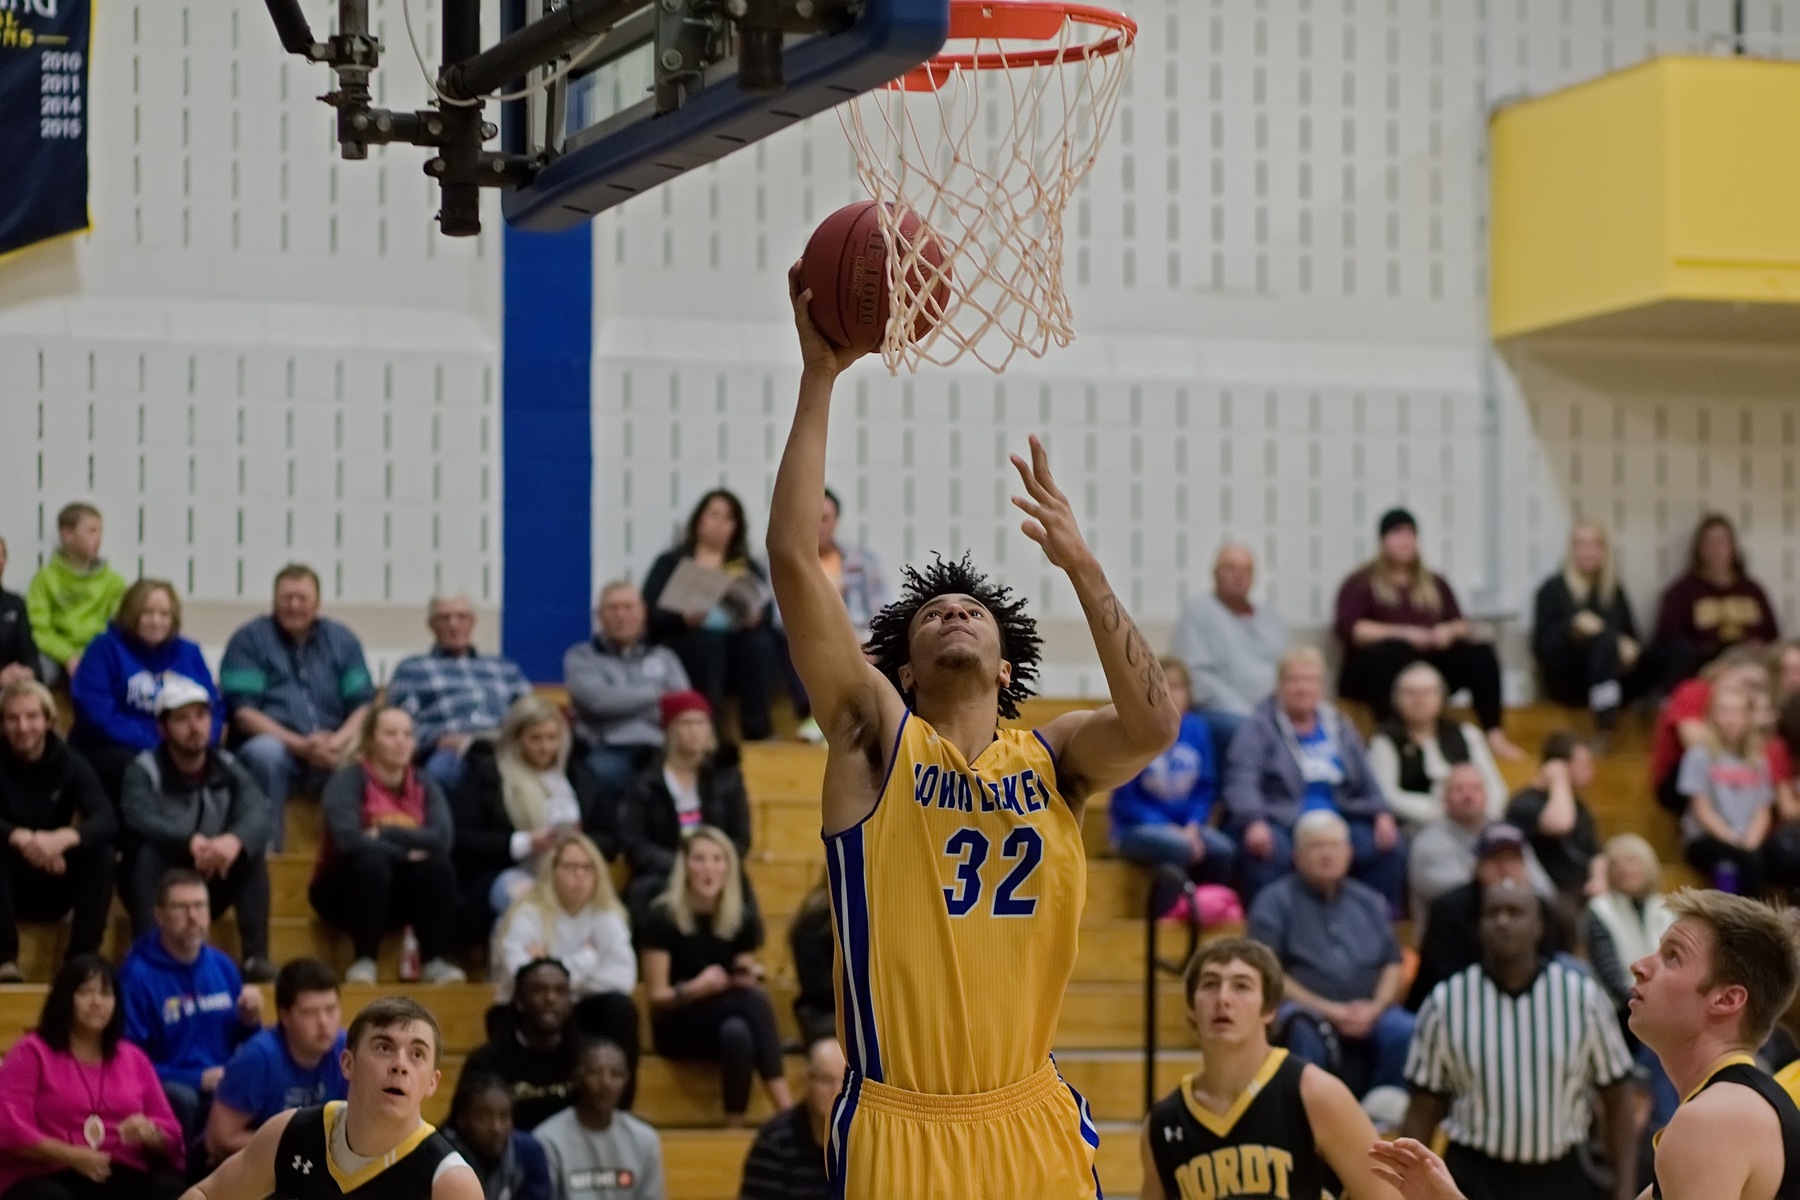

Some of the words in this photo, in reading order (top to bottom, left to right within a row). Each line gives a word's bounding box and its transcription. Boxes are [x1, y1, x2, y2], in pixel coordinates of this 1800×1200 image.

[41, 51, 83, 72] 2010
[41, 73, 80, 94] 2011
[41, 95, 82, 116] 2014
[942, 826, 1044, 917] 32
